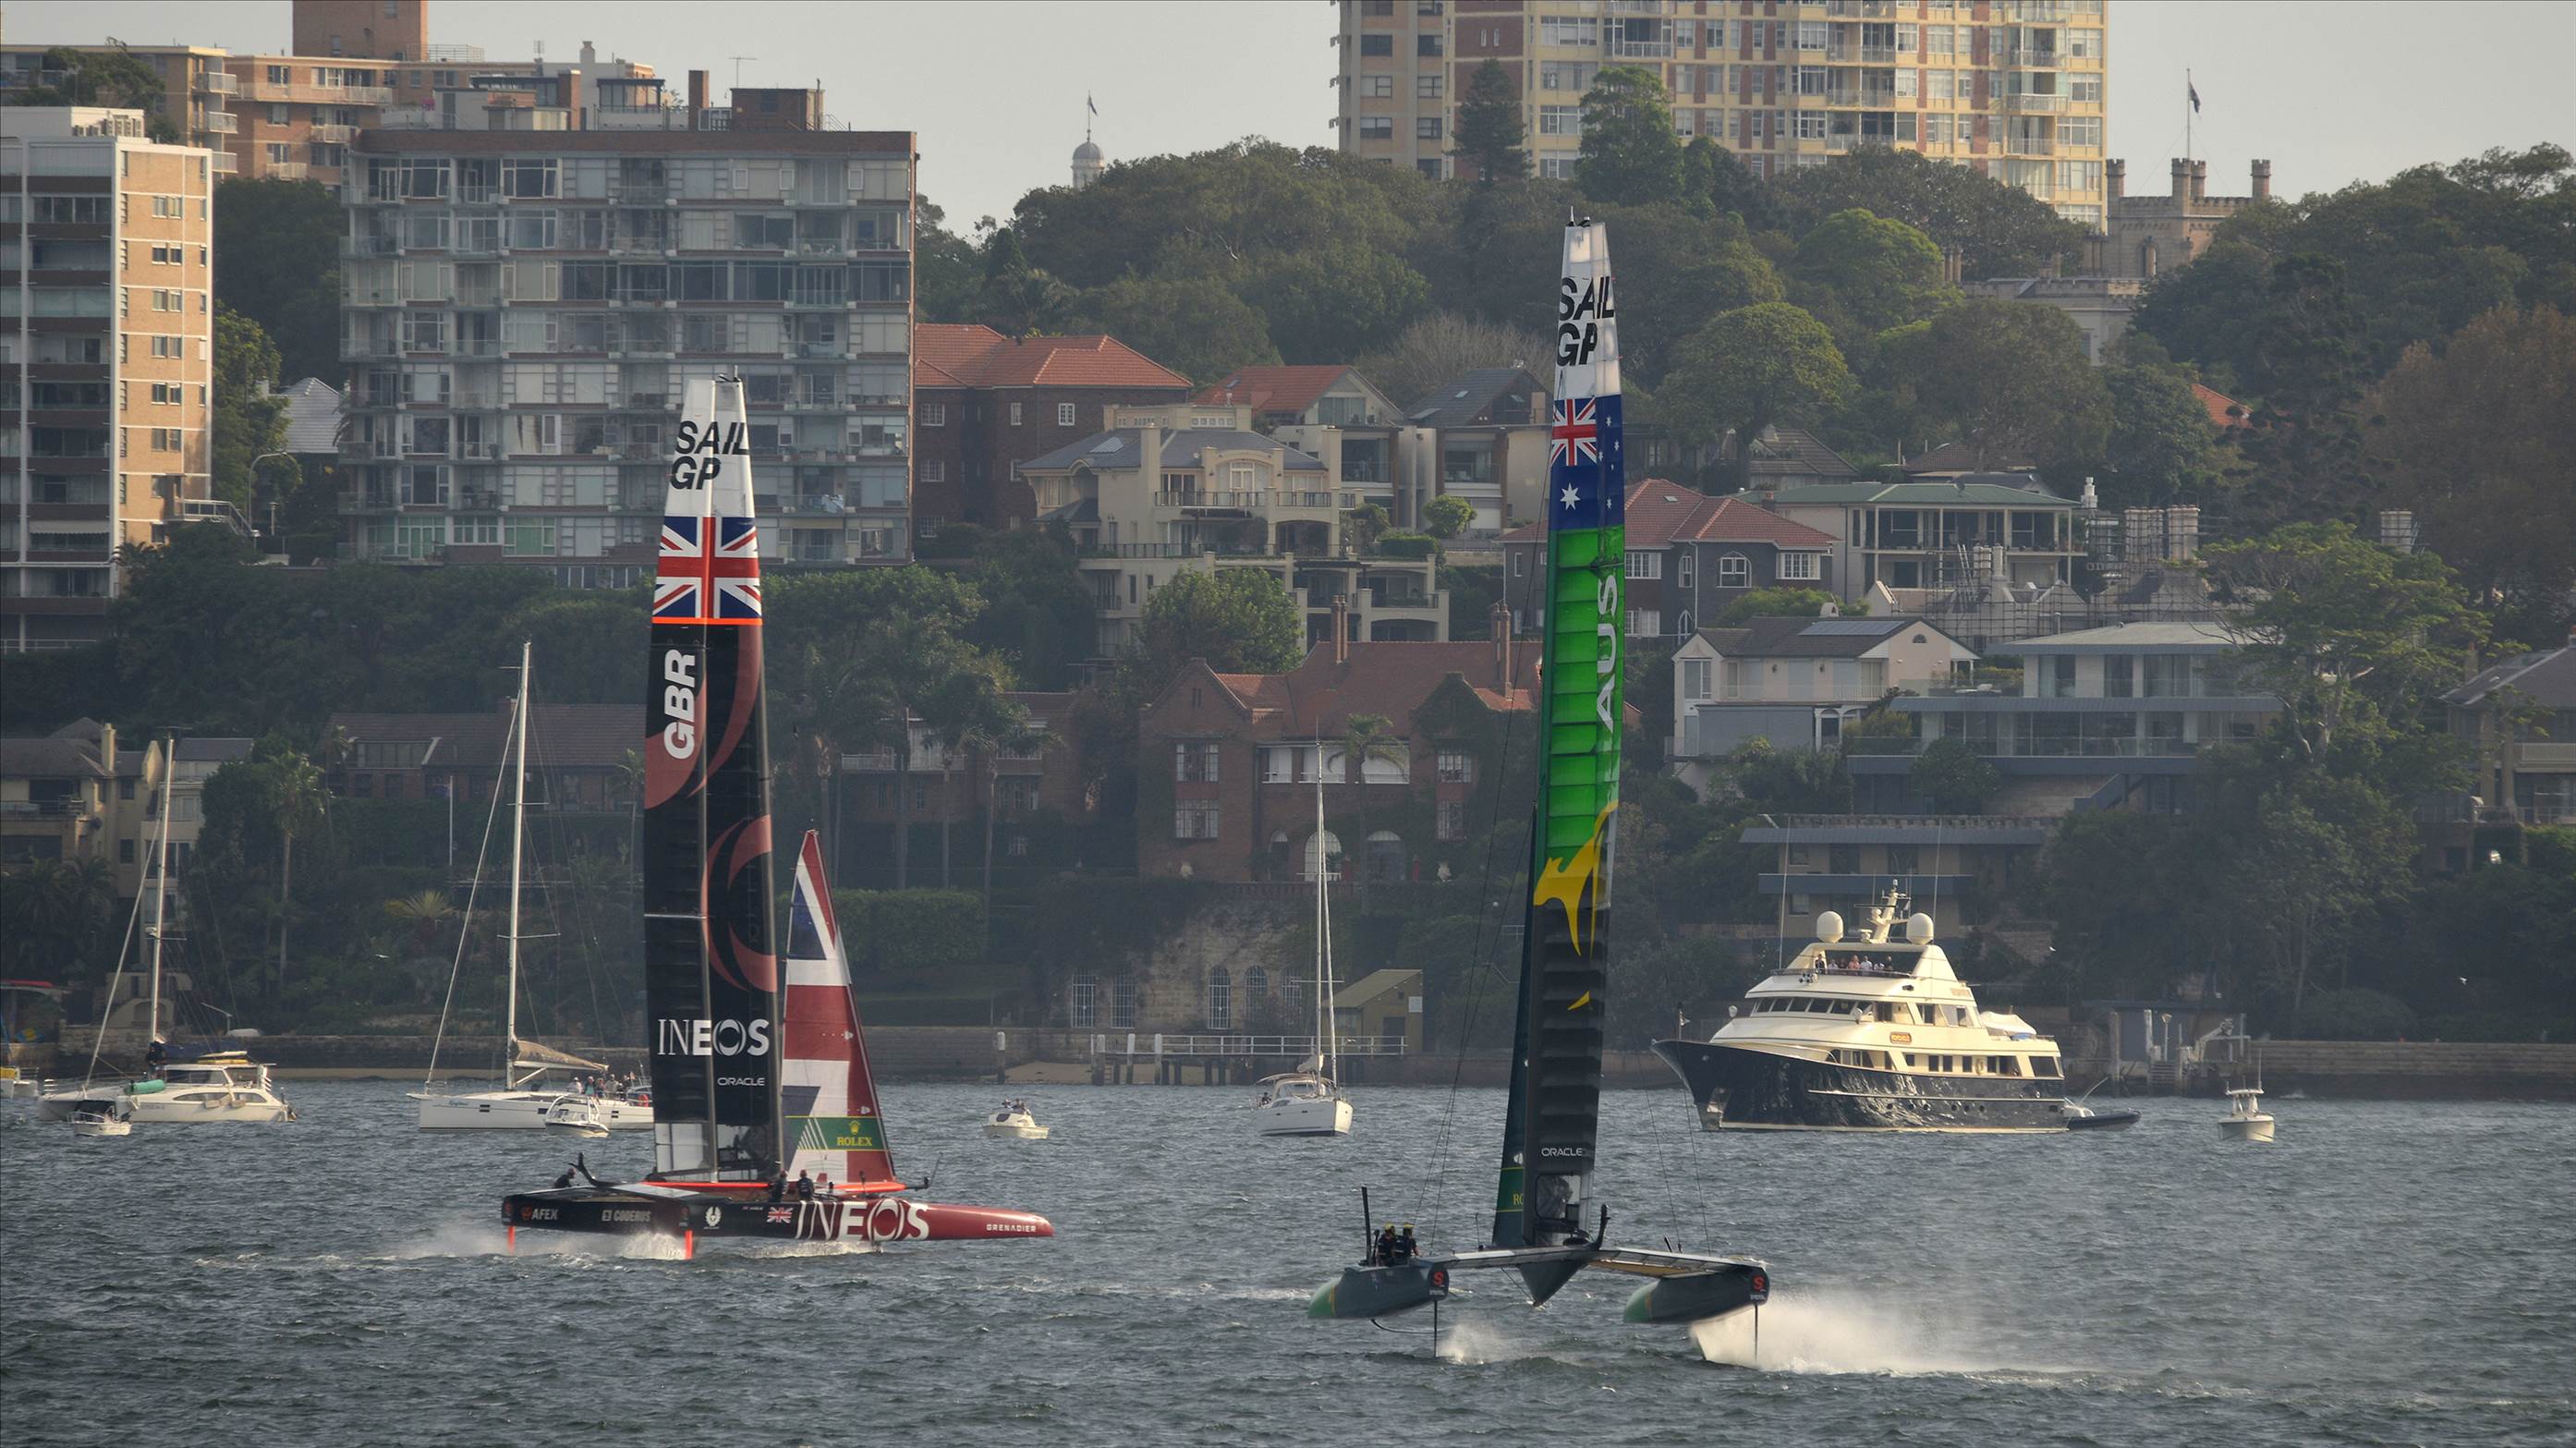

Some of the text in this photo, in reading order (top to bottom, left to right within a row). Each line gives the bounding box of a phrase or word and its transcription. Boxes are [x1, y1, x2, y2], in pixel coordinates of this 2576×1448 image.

[1559, 276, 1615, 321] SAIL
[1557, 322, 1598, 366] GP
[675, 420, 749, 455] SAIL
[670, 456, 722, 490] GP
[1597, 575, 1617, 734] AUS
[663, 649, 695, 760] GBR
[657, 1018, 770, 1056] INEOS
[717, 1077, 766, 1086] ORACLE
[836, 1137, 873, 1147] ROLEX
[1540, 1148, 1583, 1157] ORACLE
[531, 1209, 559, 1221] AFEX
[795, 1198, 930, 1242] INEOS
[986, 1223, 1038, 1233] GRENADIER
